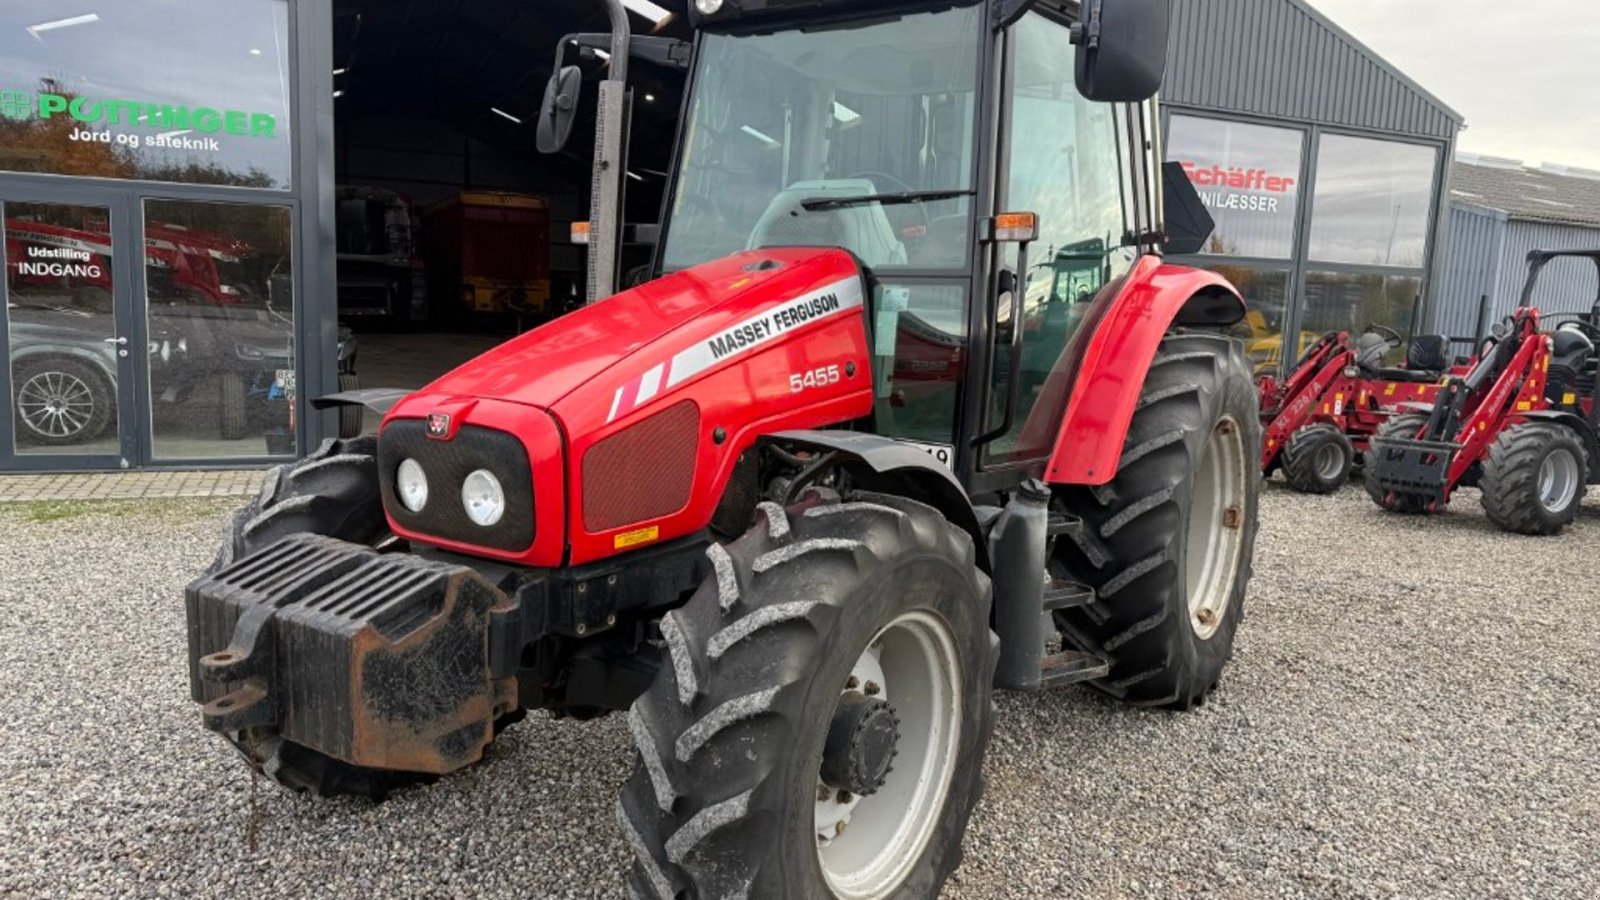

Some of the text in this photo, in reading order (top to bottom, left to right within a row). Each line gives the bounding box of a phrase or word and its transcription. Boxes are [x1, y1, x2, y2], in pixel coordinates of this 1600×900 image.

[69, 127, 110, 143] Jord
[117, 133, 139, 148] og
[28, 247, 90, 262] Udstilling
[19, 262, 101, 278] INDGANG
[708, 293, 839, 359] MASSEY FERGUSON
[789, 364, 840, 393] 5455
